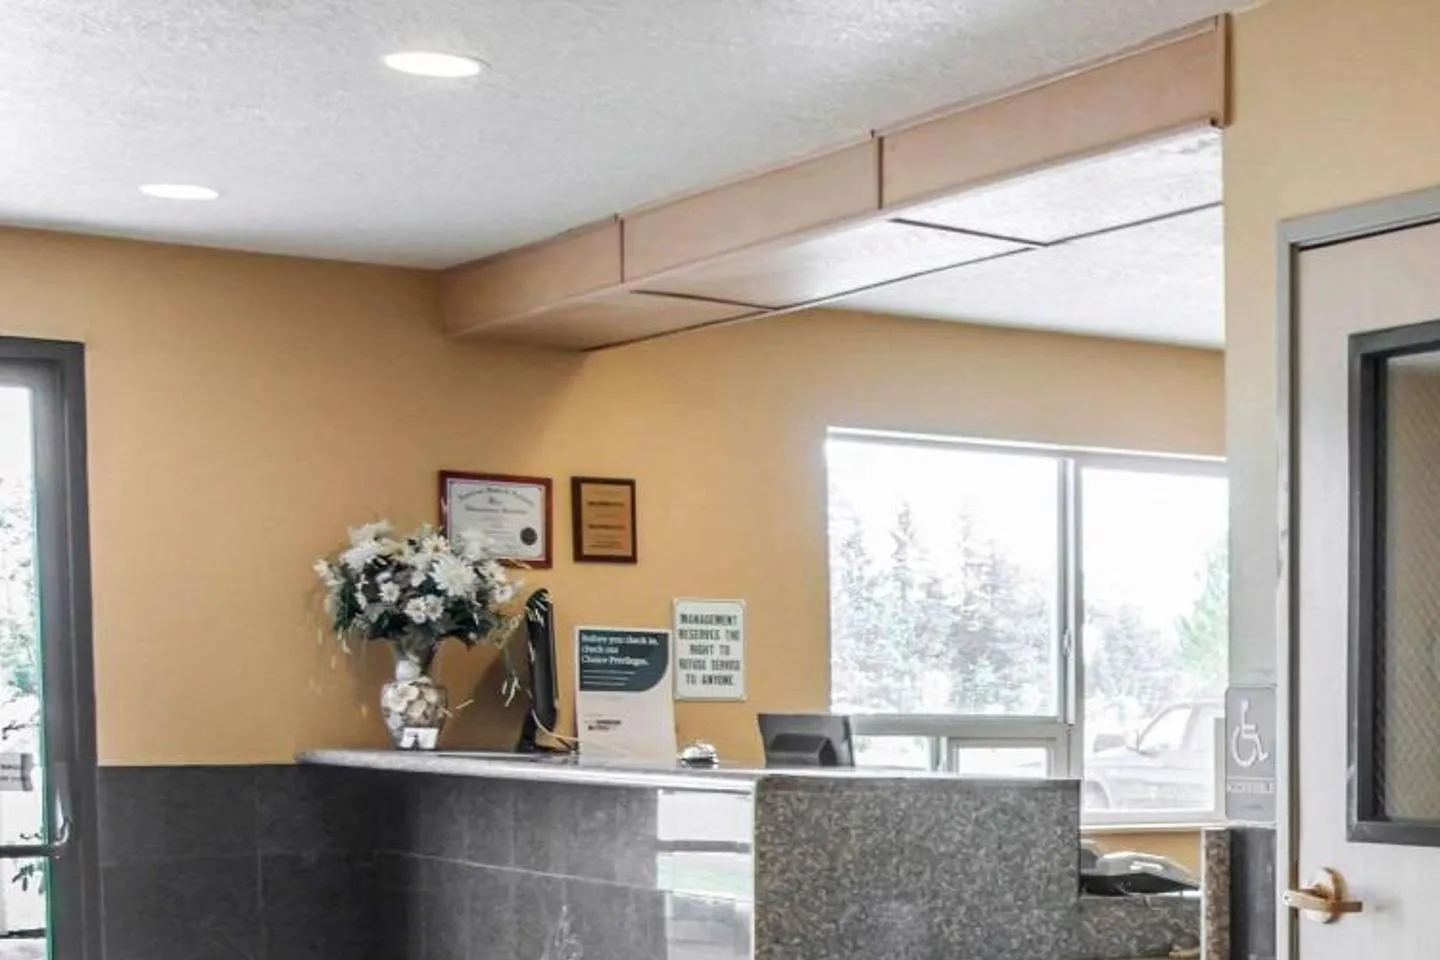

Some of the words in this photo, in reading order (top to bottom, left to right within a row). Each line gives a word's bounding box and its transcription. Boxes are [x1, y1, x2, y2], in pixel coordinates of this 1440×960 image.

[680, 614, 737, 625] MANAGEMENT
[582, 633, 607, 643] Before
[608, 636, 624, 645] you
[625, 635, 647, 644] check
[679, 629, 720, 640] RESERVES
[725, 629, 740, 641] THE
[690, 644, 713, 655] RIGHT
[719, 645, 730, 656] TO
[679, 659, 706, 670] REFUSE
[711, 660, 740, 671] SERVICE
[686, 673, 697, 685] TO
